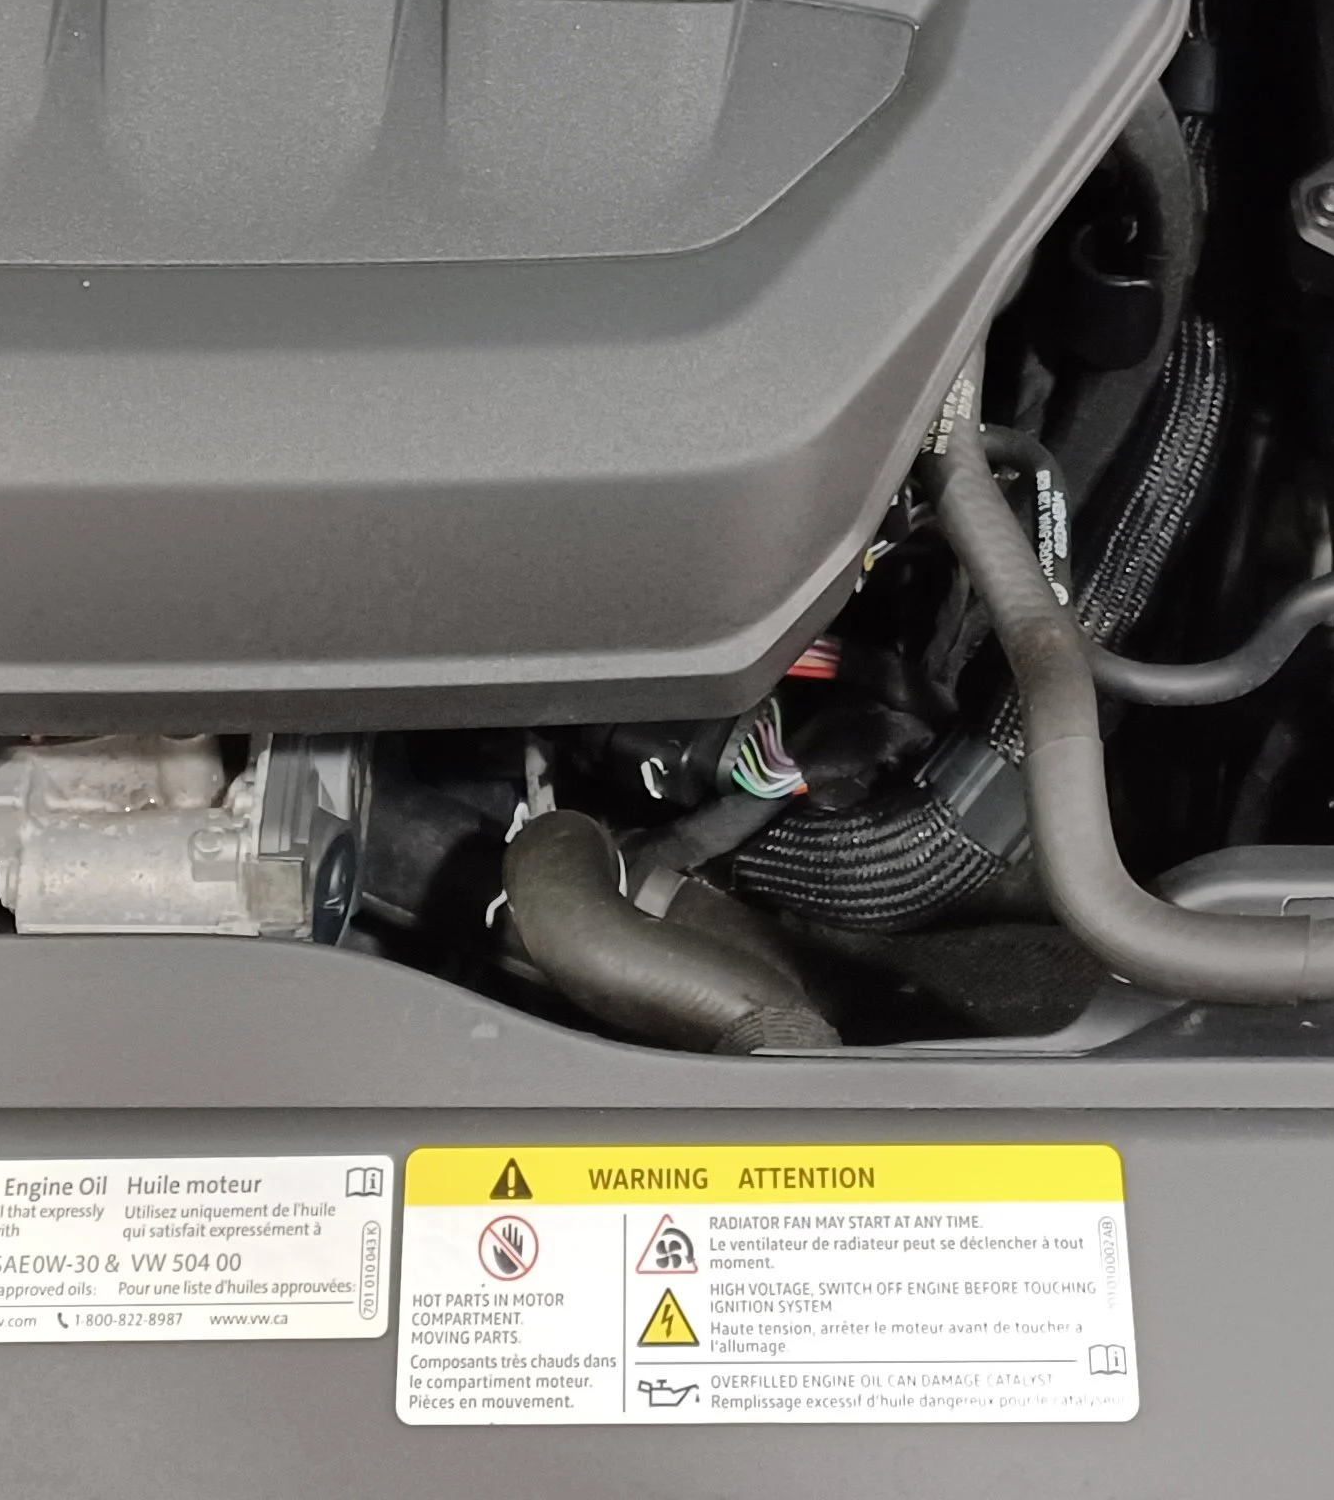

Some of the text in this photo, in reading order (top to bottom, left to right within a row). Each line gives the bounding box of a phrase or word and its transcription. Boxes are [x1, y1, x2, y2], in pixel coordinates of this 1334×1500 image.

[589, 1167, 875, 1190] WARNING ATTENTION
[4, 1175, 262, 1202] Engine Oil Huile moteur
[7, 1204, 36, 1218] that
[39, 1203, 105, 1222] expressly
[124, 1202, 336, 1222] Utilisez uniquement de l'huile
[366, 1225, 378, 1236] K
[709, 1215, 984, 1229] RADIATOR FAN MAY START AT ANY TIME.
[122, 1221, 322, 1242] qui satisfait expressément à
[709, 1235, 1084, 1252] Le ventilateur de radiateur peut se déclencher à tout
[105, 1254, 120, 1274] &
[131, 1253, 167, 1273] VW
[172, 1253, 210, 1272] 504
[216, 1253, 242, 1272] 00
[710, 1257, 775, 1269] moment.
[364, 1264, 376, 1289] 010
[68, 1281, 97, 1296] oils:
[118, 1278, 357, 1298] Pour une liste d'huiles approuvées:
[710, 1281, 1096, 1297] HIGH VOLTAGE, SWITCH OFF ENGINE BEFORE TOUCHING
[363, 1293, 375, 1314] 701
[412, 1293, 564, 1307] HOT PARTS IN MOTOR
[710, 1300, 774, 1314] IGNITION
[74, 1313, 183, 1327] 1-800-822-8987
[210, 1313, 288, 1326] www.vw.ca
[411, 1312, 524, 1326] COMPARTMENT.
[411, 1330, 522, 1344] MOVING PARTS.
[710, 1320, 1070, 1337] Haute tension, arrêter le moteur avant de toucher
[410, 1353, 617, 1372] Composants très chauds dans
[409, 1374, 594, 1392] le compartiment moteur.
[711, 1374, 798, 1388] OVERFILLED
[802, 1374, 855, 1388] ENGINE
[861, 1374, 883, 1388] OIL
[887, 1374, 917, 1388] CAN
[921, 1374, 980, 1388] DAMAGE
[409, 1394, 574, 1409] Pièces en mouvement.
[711, 1394, 802, 1412] Remplissage
[806, 1393, 862, 1408] excessif
[866, 1393, 915, 1408] d'huile
[919, 1393, 994, 1411] dangereux
